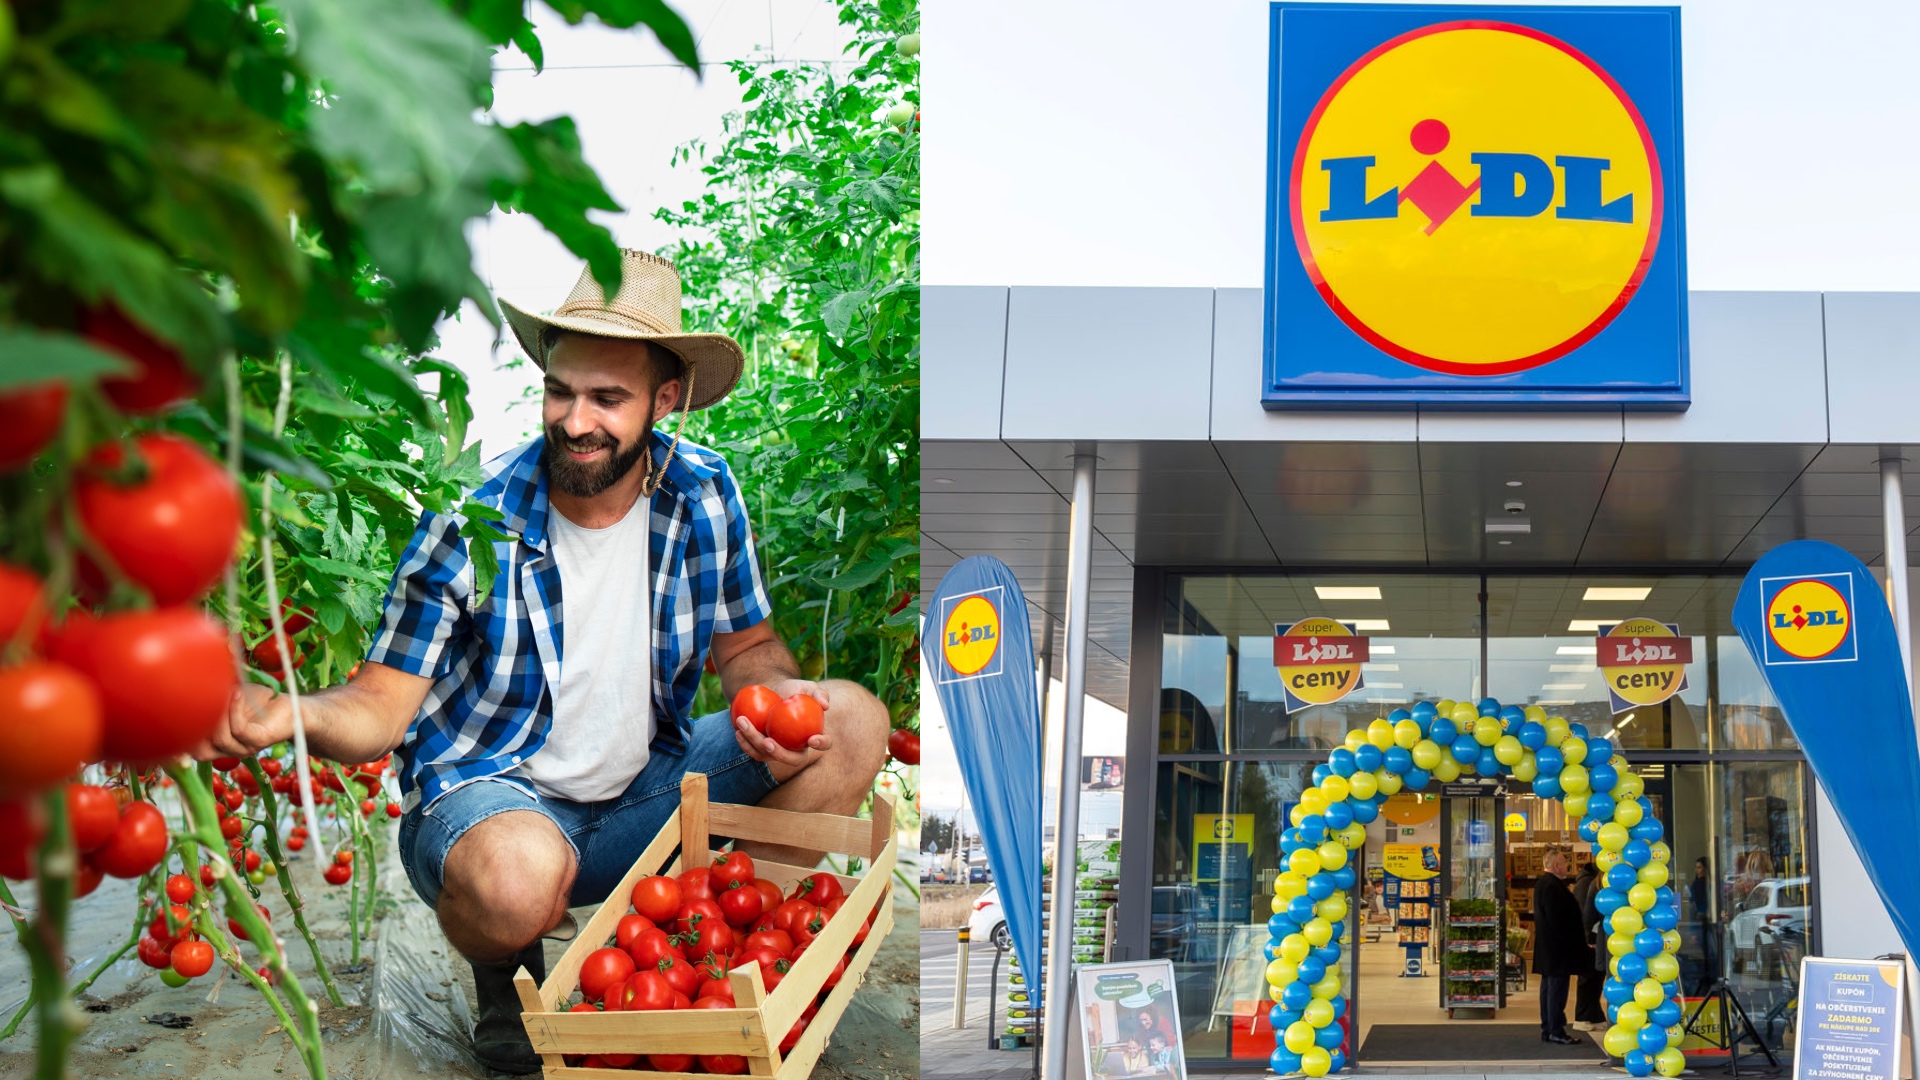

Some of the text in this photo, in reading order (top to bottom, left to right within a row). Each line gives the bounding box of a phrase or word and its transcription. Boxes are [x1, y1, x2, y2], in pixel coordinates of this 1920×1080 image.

[1320, 119, 1634, 236] LIDL
[1773, 605, 1844, 631] LIDL
[948, 622, 995, 647] LIDL
[1302, 624, 1333, 634] super
[1625, 625, 1655, 635] super
[1293, 637, 1353, 664] LIDL
[1616, 638, 1676, 665] LIDL
[1292, 670, 1350, 690] ceny
[1616, 671, 1674, 691] ceny
[1834, 972, 1870, 982] ZÍSKAJTE
[1837, 987, 1865, 996] KUPÓN
[1828, 1002, 1886, 1014] OBČERSTVENIE
[1827, 1014, 1872, 1024] ZADARMO
[1826, 1044, 1853, 1053] NEMÁTE
[1854, 1047, 1881, 1056] KUPÓN,
[1822, 1053, 1873, 1063] OBČERSTVENIE
[1823, 1062, 1872, 1072] POSKYTUJEME
[1818, 1069, 1864, 1079] ZVÝHODNENÉ
